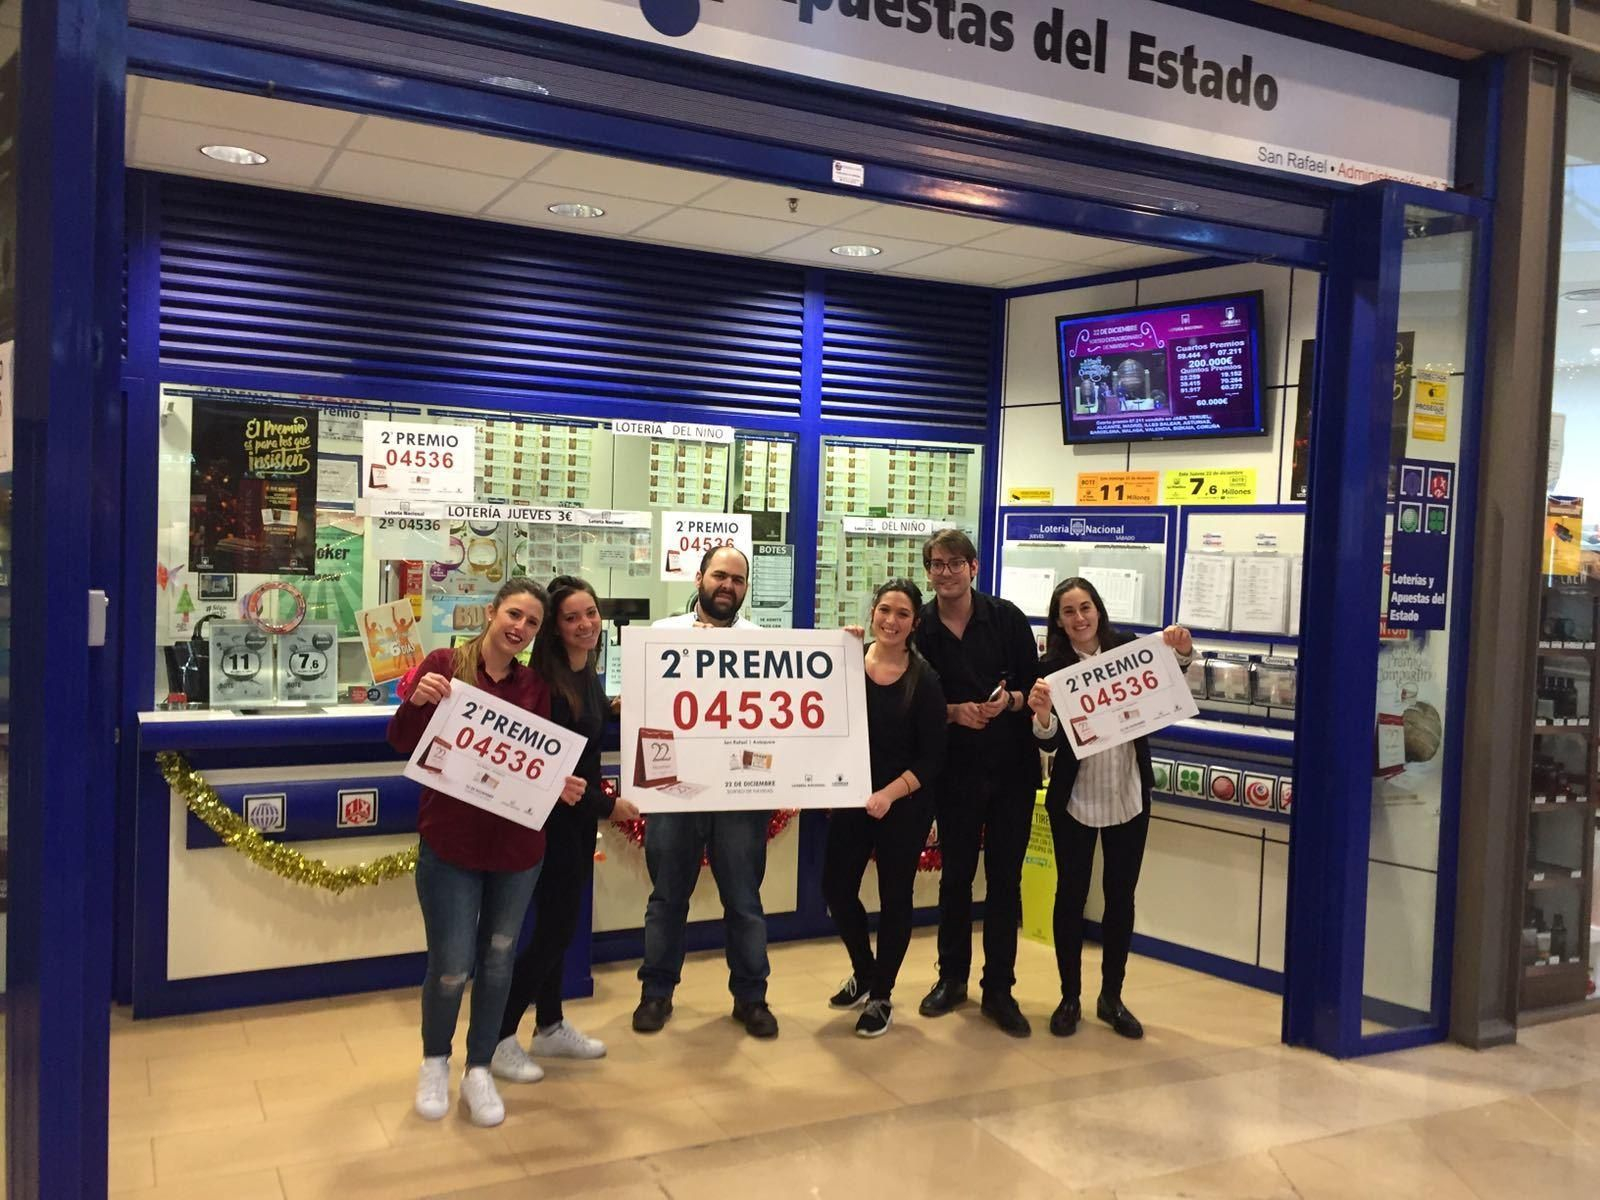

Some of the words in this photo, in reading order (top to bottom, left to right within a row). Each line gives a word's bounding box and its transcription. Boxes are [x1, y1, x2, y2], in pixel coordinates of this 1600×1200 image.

[779, 0, 1014, 52] puestas
[1033, 15, 1107, 74] del
[1128, 31, 1278, 111] Estado
[1257, 146, 1283, 165] San
[1287, 152, 1327, 173] Rafael
[1176, 344, 1208, 352] Cuartos
[1210, 340, 1245, 349] Premios
[1217, 348, 1242, 356] 07.211
[1188, 356, 1233, 368] 200.000€
[1211, 364, 1242, 372] Premios
[1196, 398, 1228, 406] 60.000€
[320, 407, 360, 419] remio
[264, 416, 308, 438] Premio
[672, 425, 691, 436] DEL
[255, 439, 278, 454] para
[279, 434, 293, 447] los
[294, 436, 311, 453] que
[396, 432, 459, 448] PREMIO
[248, 447, 311, 475] insisten
[386, 449, 454, 469] 04536
[1100, 484, 1124, 501] 11
[448, 505, 501, 519] LOTERÍA
[507, 508, 552, 521] JUEVES
[558, 510, 573, 522] 3€
[379, 518, 394, 530] 2º
[398, 518, 441, 531] 04536
[688, 521, 739, 534] PREMIO
[881, 520, 898, 532] DEL
[900, 520, 926, 532] NIÑO
[1085, 524, 1125, 534] Nacional
[317, 543, 351, 560] oker
[759, 545, 787, 554] BOTES
[1392, 573, 1427, 586] Loterías
[1428, 577, 1434, 589] y
[1391, 592, 1430, 605] Apuestas
[1432, 593, 1445, 604] del
[1390, 609, 1419, 621] Estado
[229, 653, 249, 670] 11
[661, 648, 690, 679] 2º
[696, 650, 833, 679] PREMIO
[1081, 649, 1154, 688] PREMIO
[1079, 670, 1159, 714] 04536
[673, 690, 825, 730] 04536
[480, 709, 561, 756] PREMIO
[433, 746, 447, 760] 22
[455, 726, 545, 780] 04536
[651, 742, 671, 762] 22
